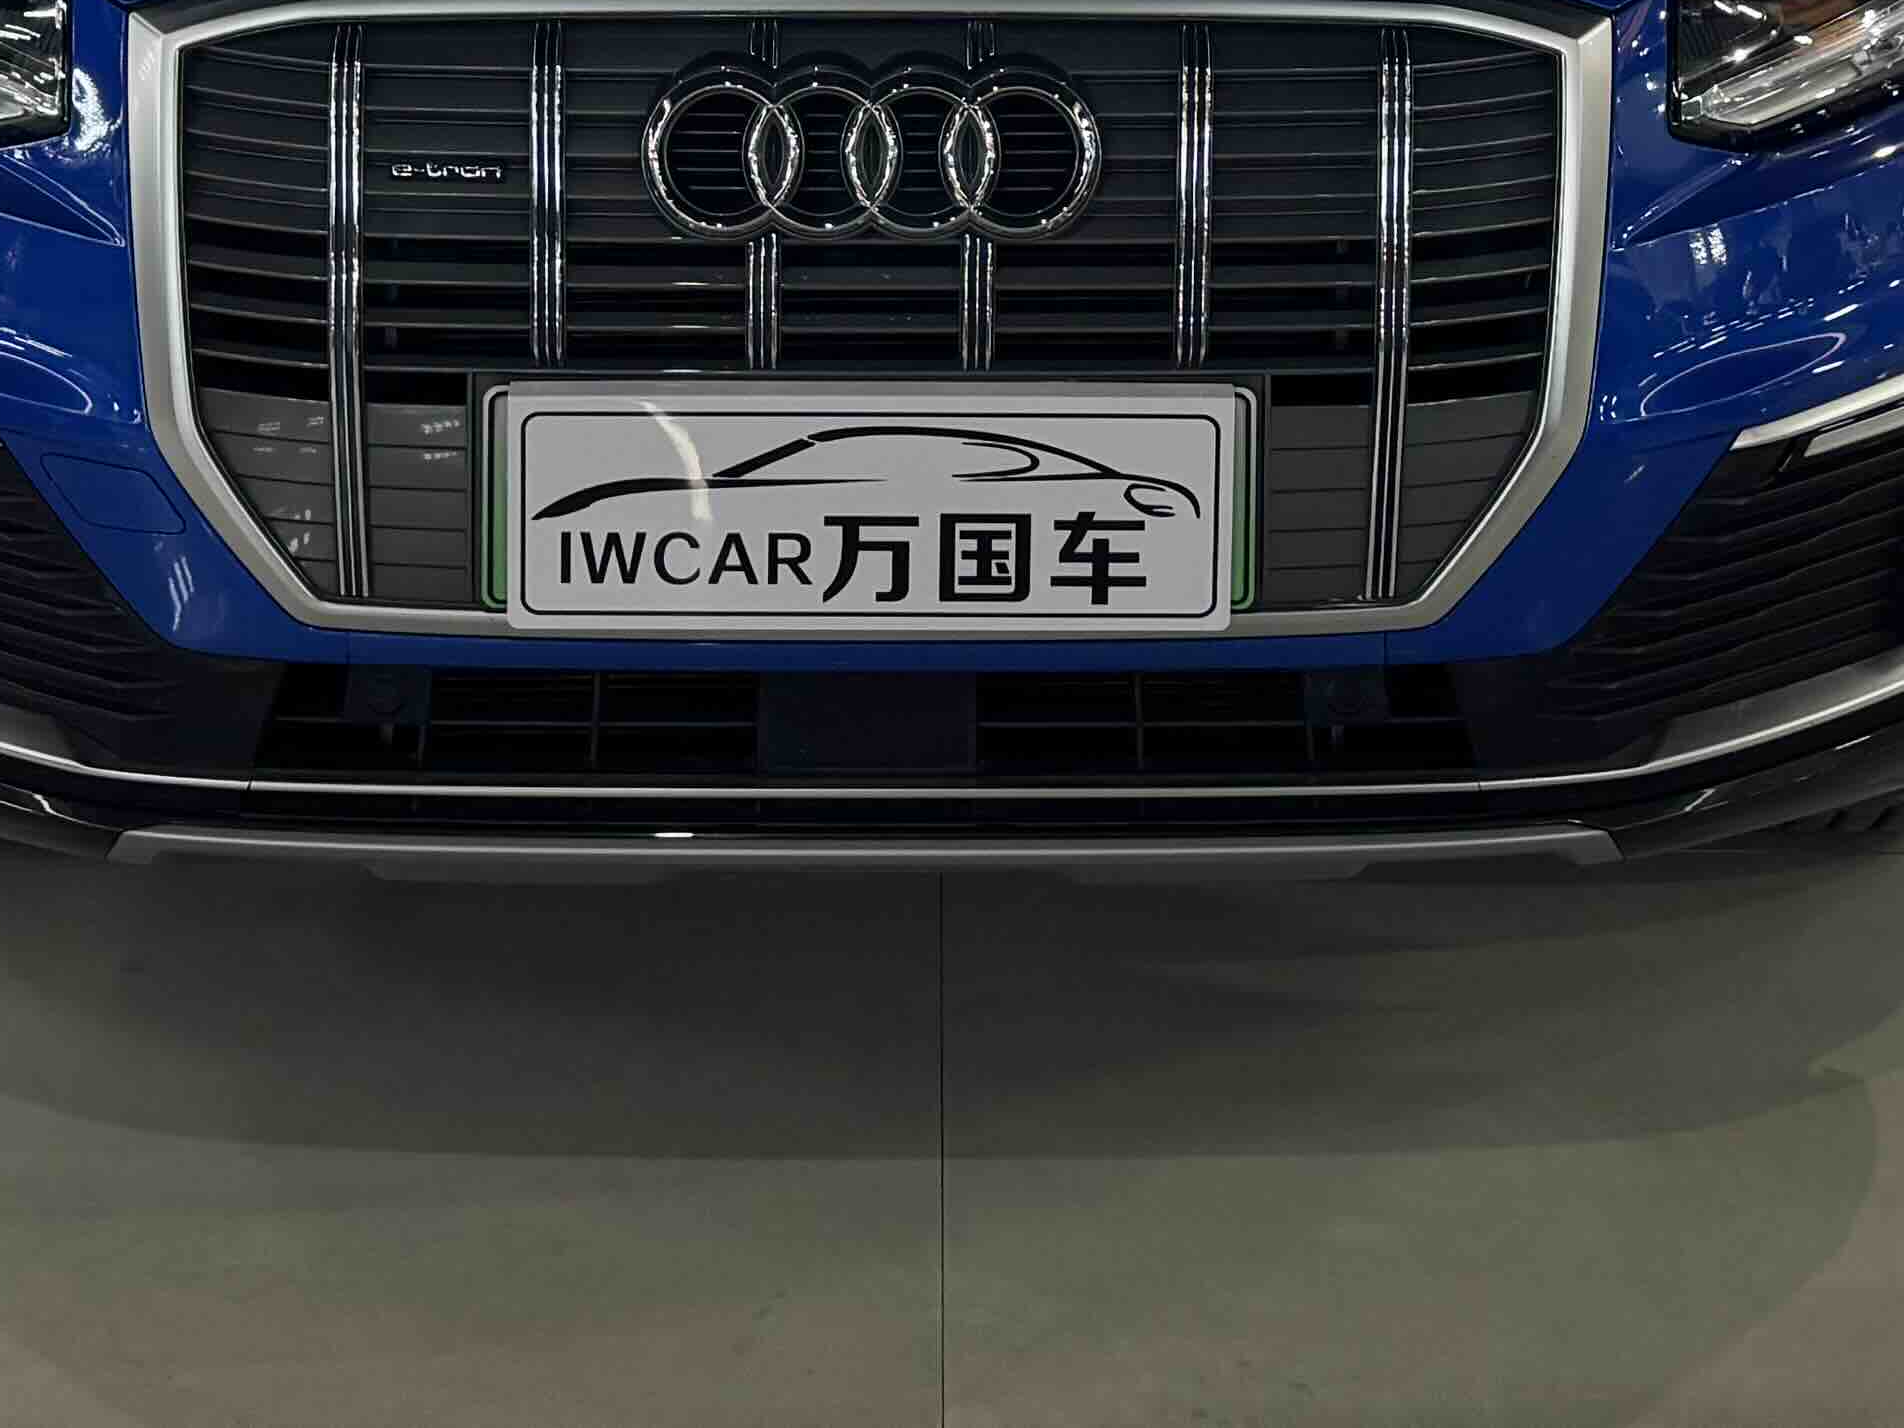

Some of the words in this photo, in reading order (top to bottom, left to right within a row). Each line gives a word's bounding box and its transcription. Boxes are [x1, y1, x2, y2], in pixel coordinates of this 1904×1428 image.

[391, 161, 503, 180] e-tron
[560, 511, 1149, 606] IWCAR万国车
